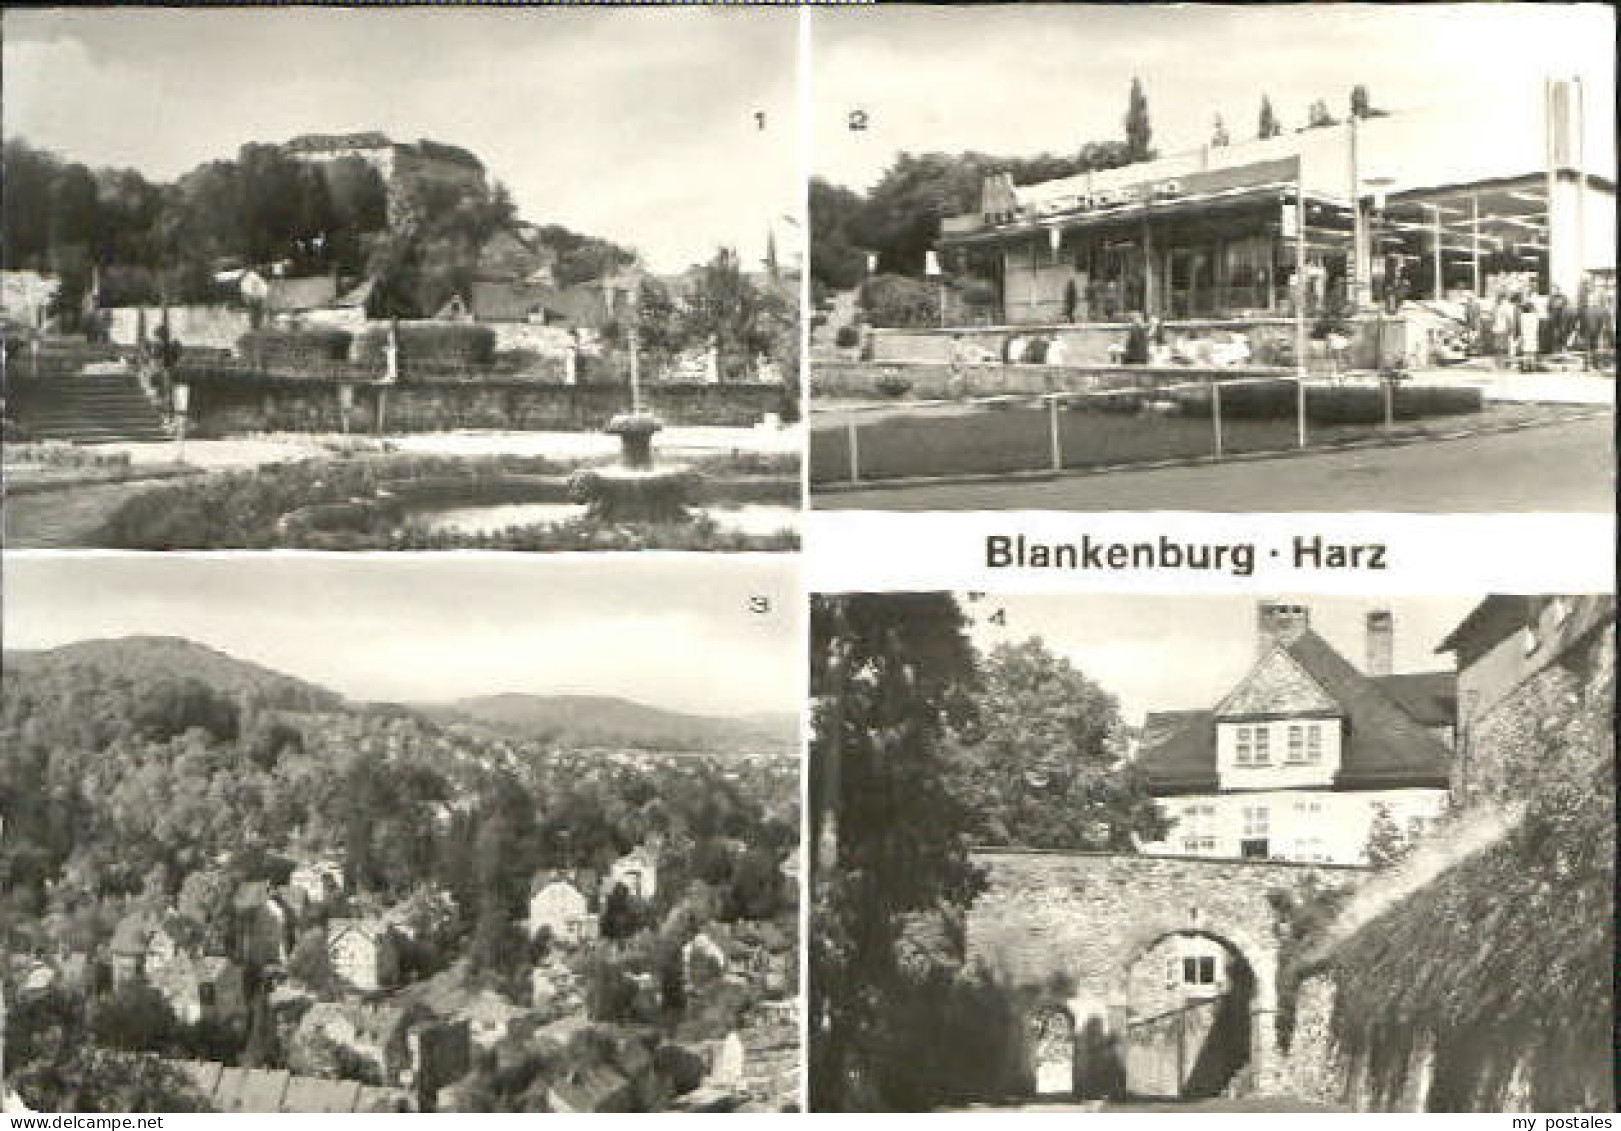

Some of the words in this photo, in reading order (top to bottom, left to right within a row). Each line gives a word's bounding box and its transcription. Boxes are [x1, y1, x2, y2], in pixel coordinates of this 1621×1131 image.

[753, 111, 766, 132] 1
[848, 109, 869, 132] 2
[985, 534, 1256, 577] Blankenburg
[1294, 534, 1387, 570] Harz
[749, 595, 772, 614] 3
[986, 607, 1006, 627] 4
